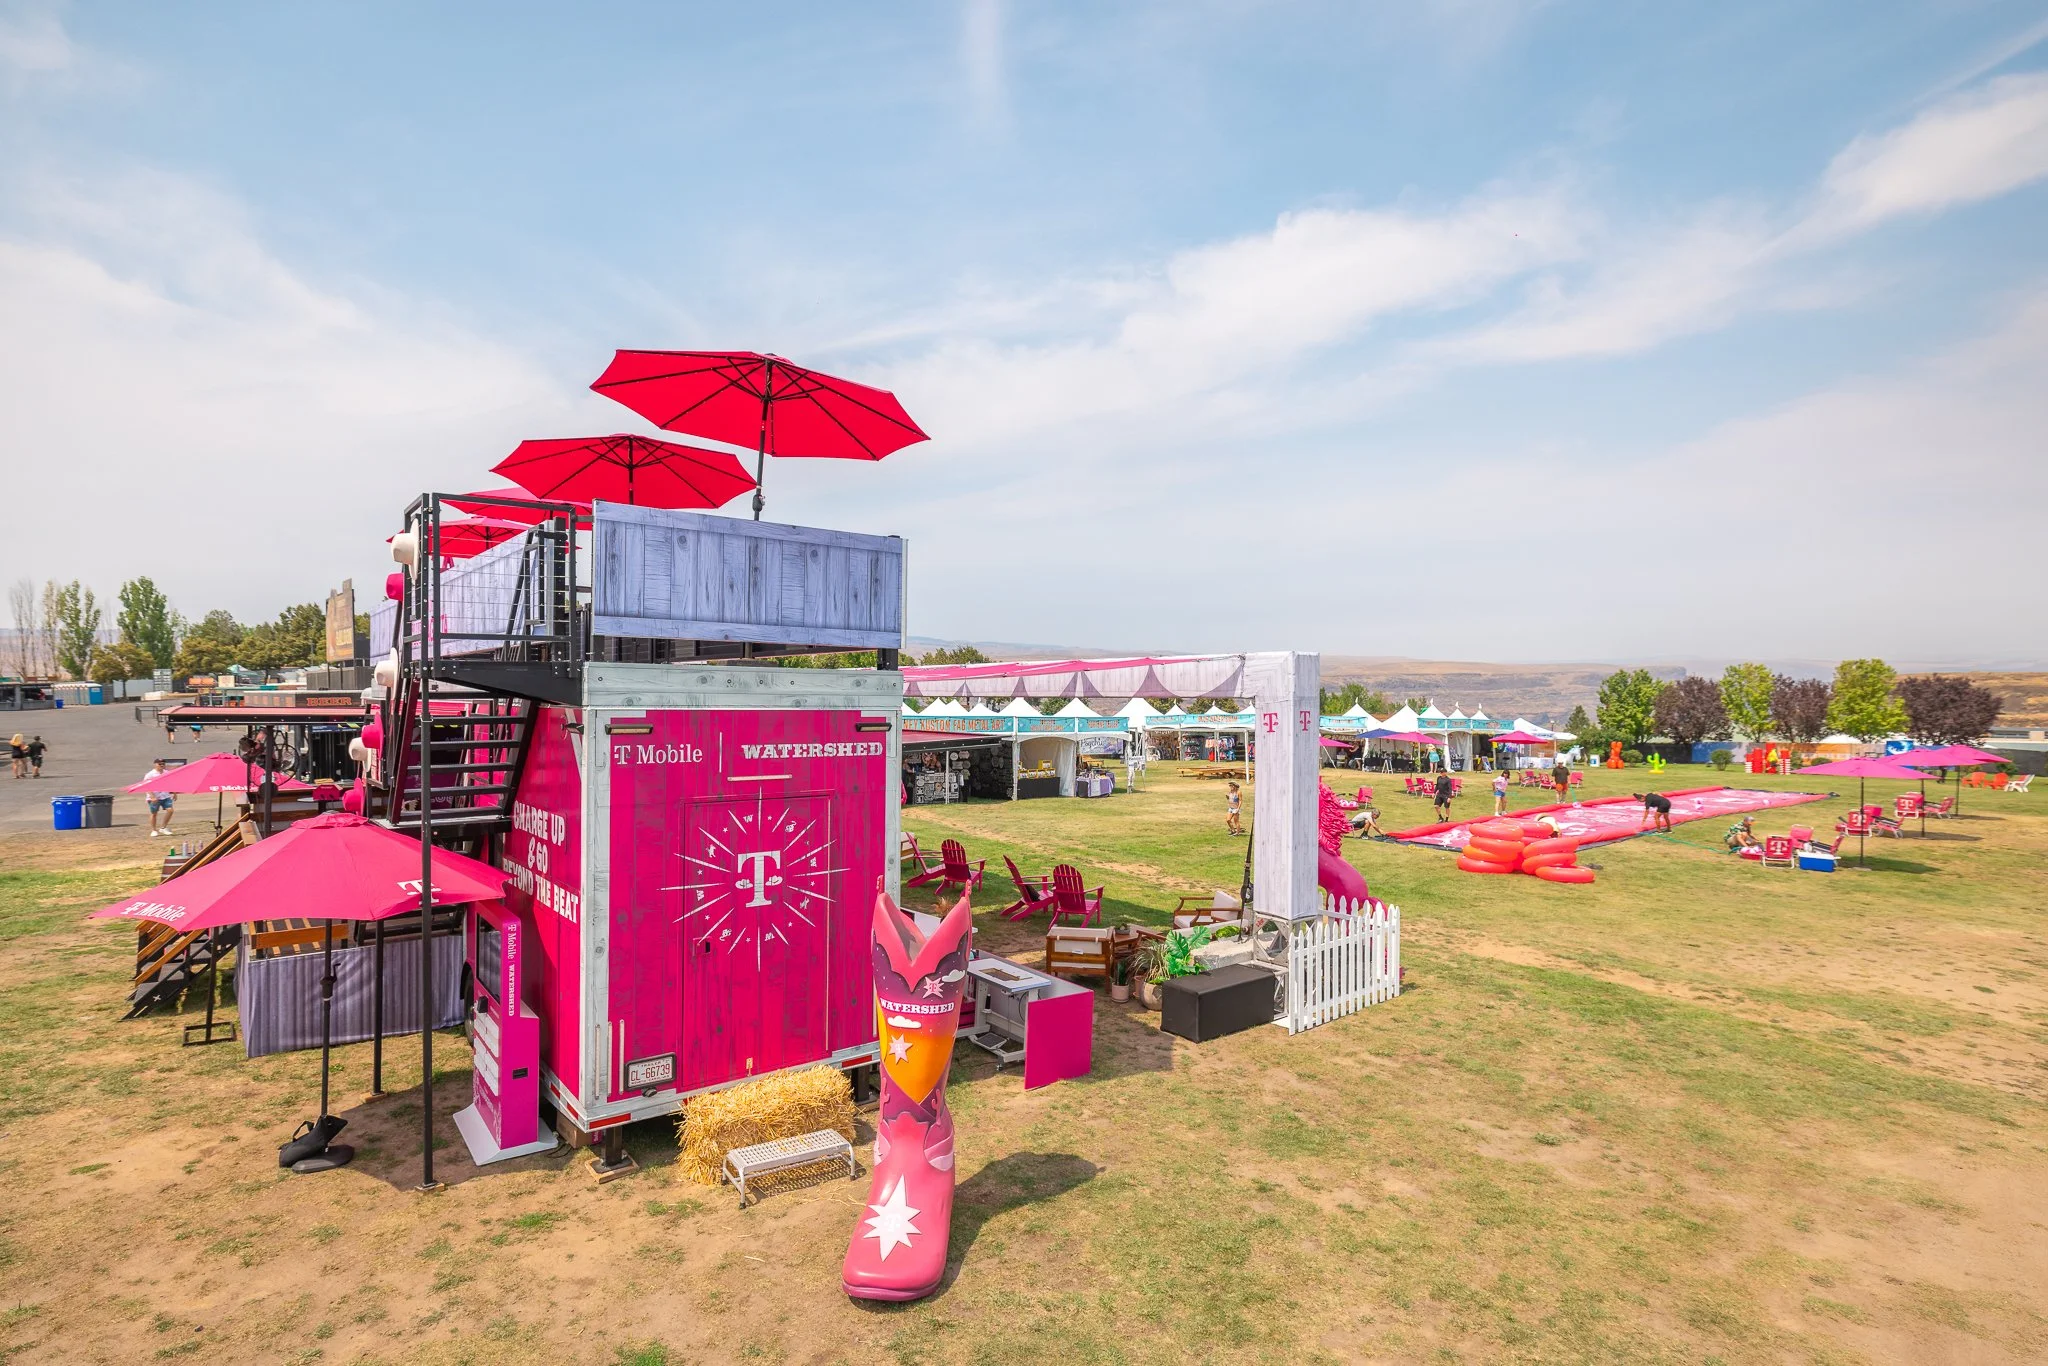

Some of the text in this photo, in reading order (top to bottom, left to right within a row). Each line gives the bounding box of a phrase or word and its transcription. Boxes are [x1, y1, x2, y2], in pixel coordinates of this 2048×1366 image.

[306, 697, 352, 706] BEER
[1263, 713, 1279, 733] T
[1299, 710, 1311, 731] T
[636, 744, 703, 764] Mobile
[741, 742, 882, 759] WATERSHED
[513, 800, 565, 846] CHARGE UP
[527, 837, 549, 874] & GO
[737, 850, 781, 908] T
[502, 857, 579, 923] BEYOND THE BEAT
[134, 902, 186, 921] Mobile
[507, 933, 517, 960] Mobile
[508, 964, 516, 1017] WATERSHED
[880, 997, 955, 1015] WATERSHED
[630, 1063, 671, 1082] CL-66739
